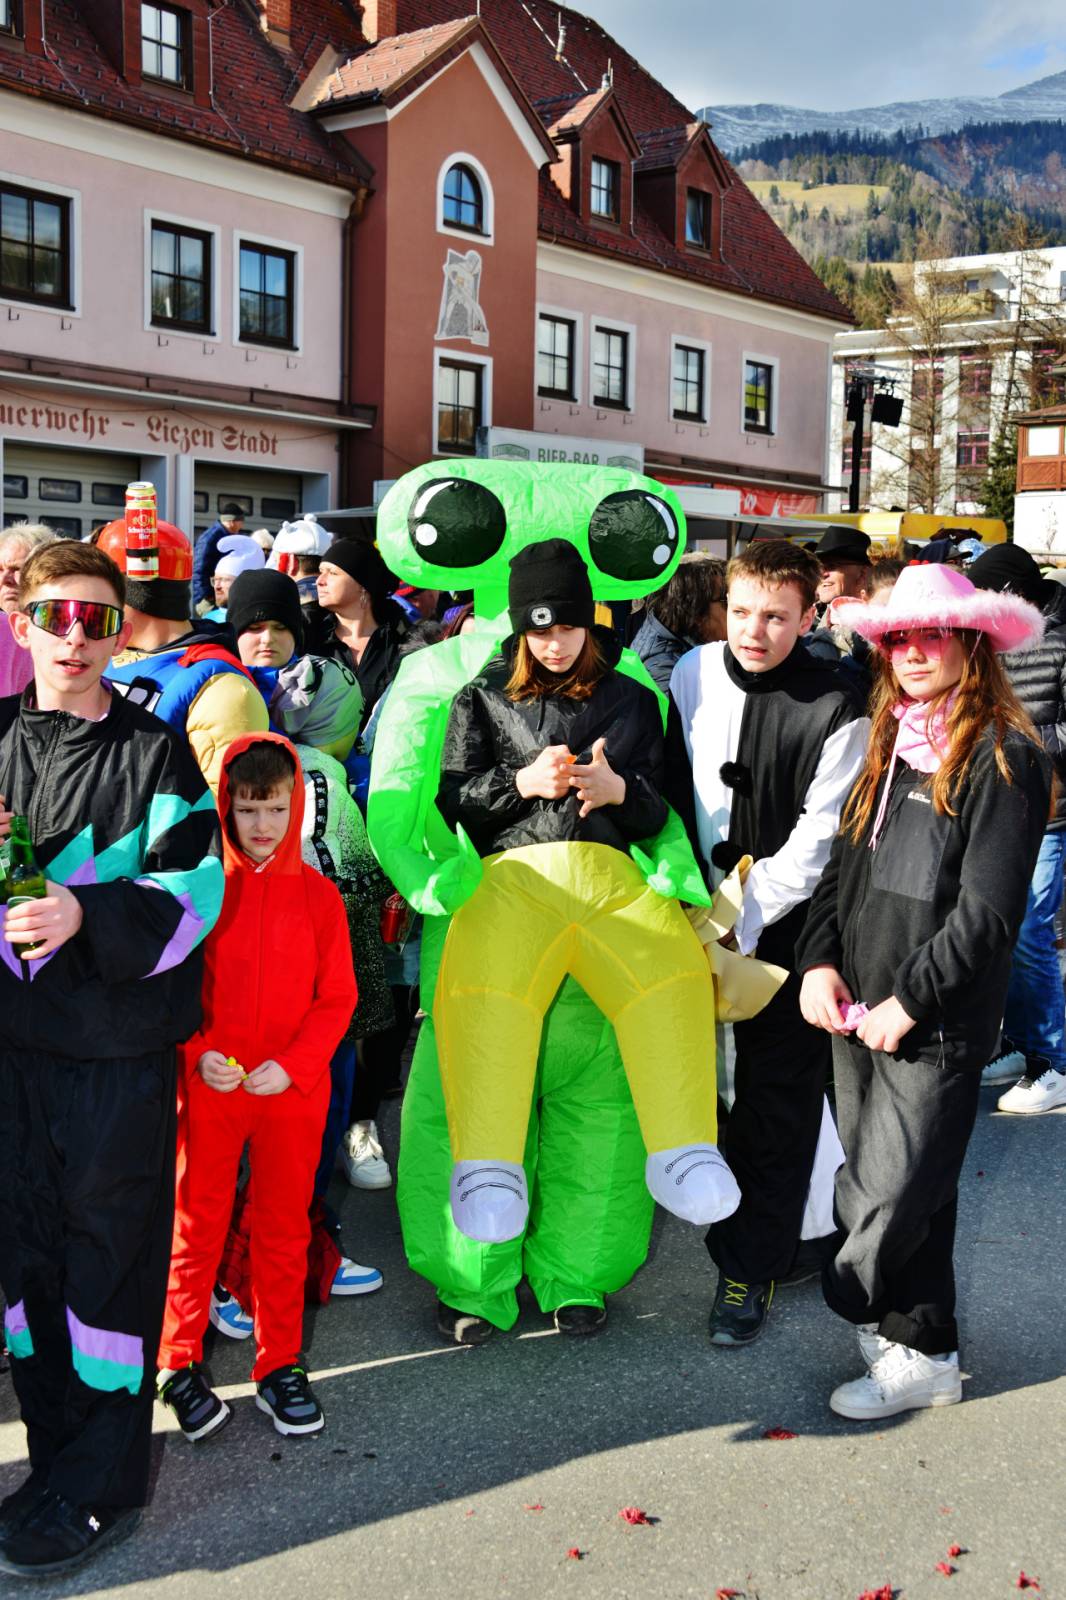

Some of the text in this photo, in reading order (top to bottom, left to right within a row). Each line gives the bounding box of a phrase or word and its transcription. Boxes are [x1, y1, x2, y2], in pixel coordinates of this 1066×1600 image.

[146, 415, 214, 453] Liezen
[221, 425, 279, 456] Stadt
[537, 448, 600, 466] BIER-BAR
